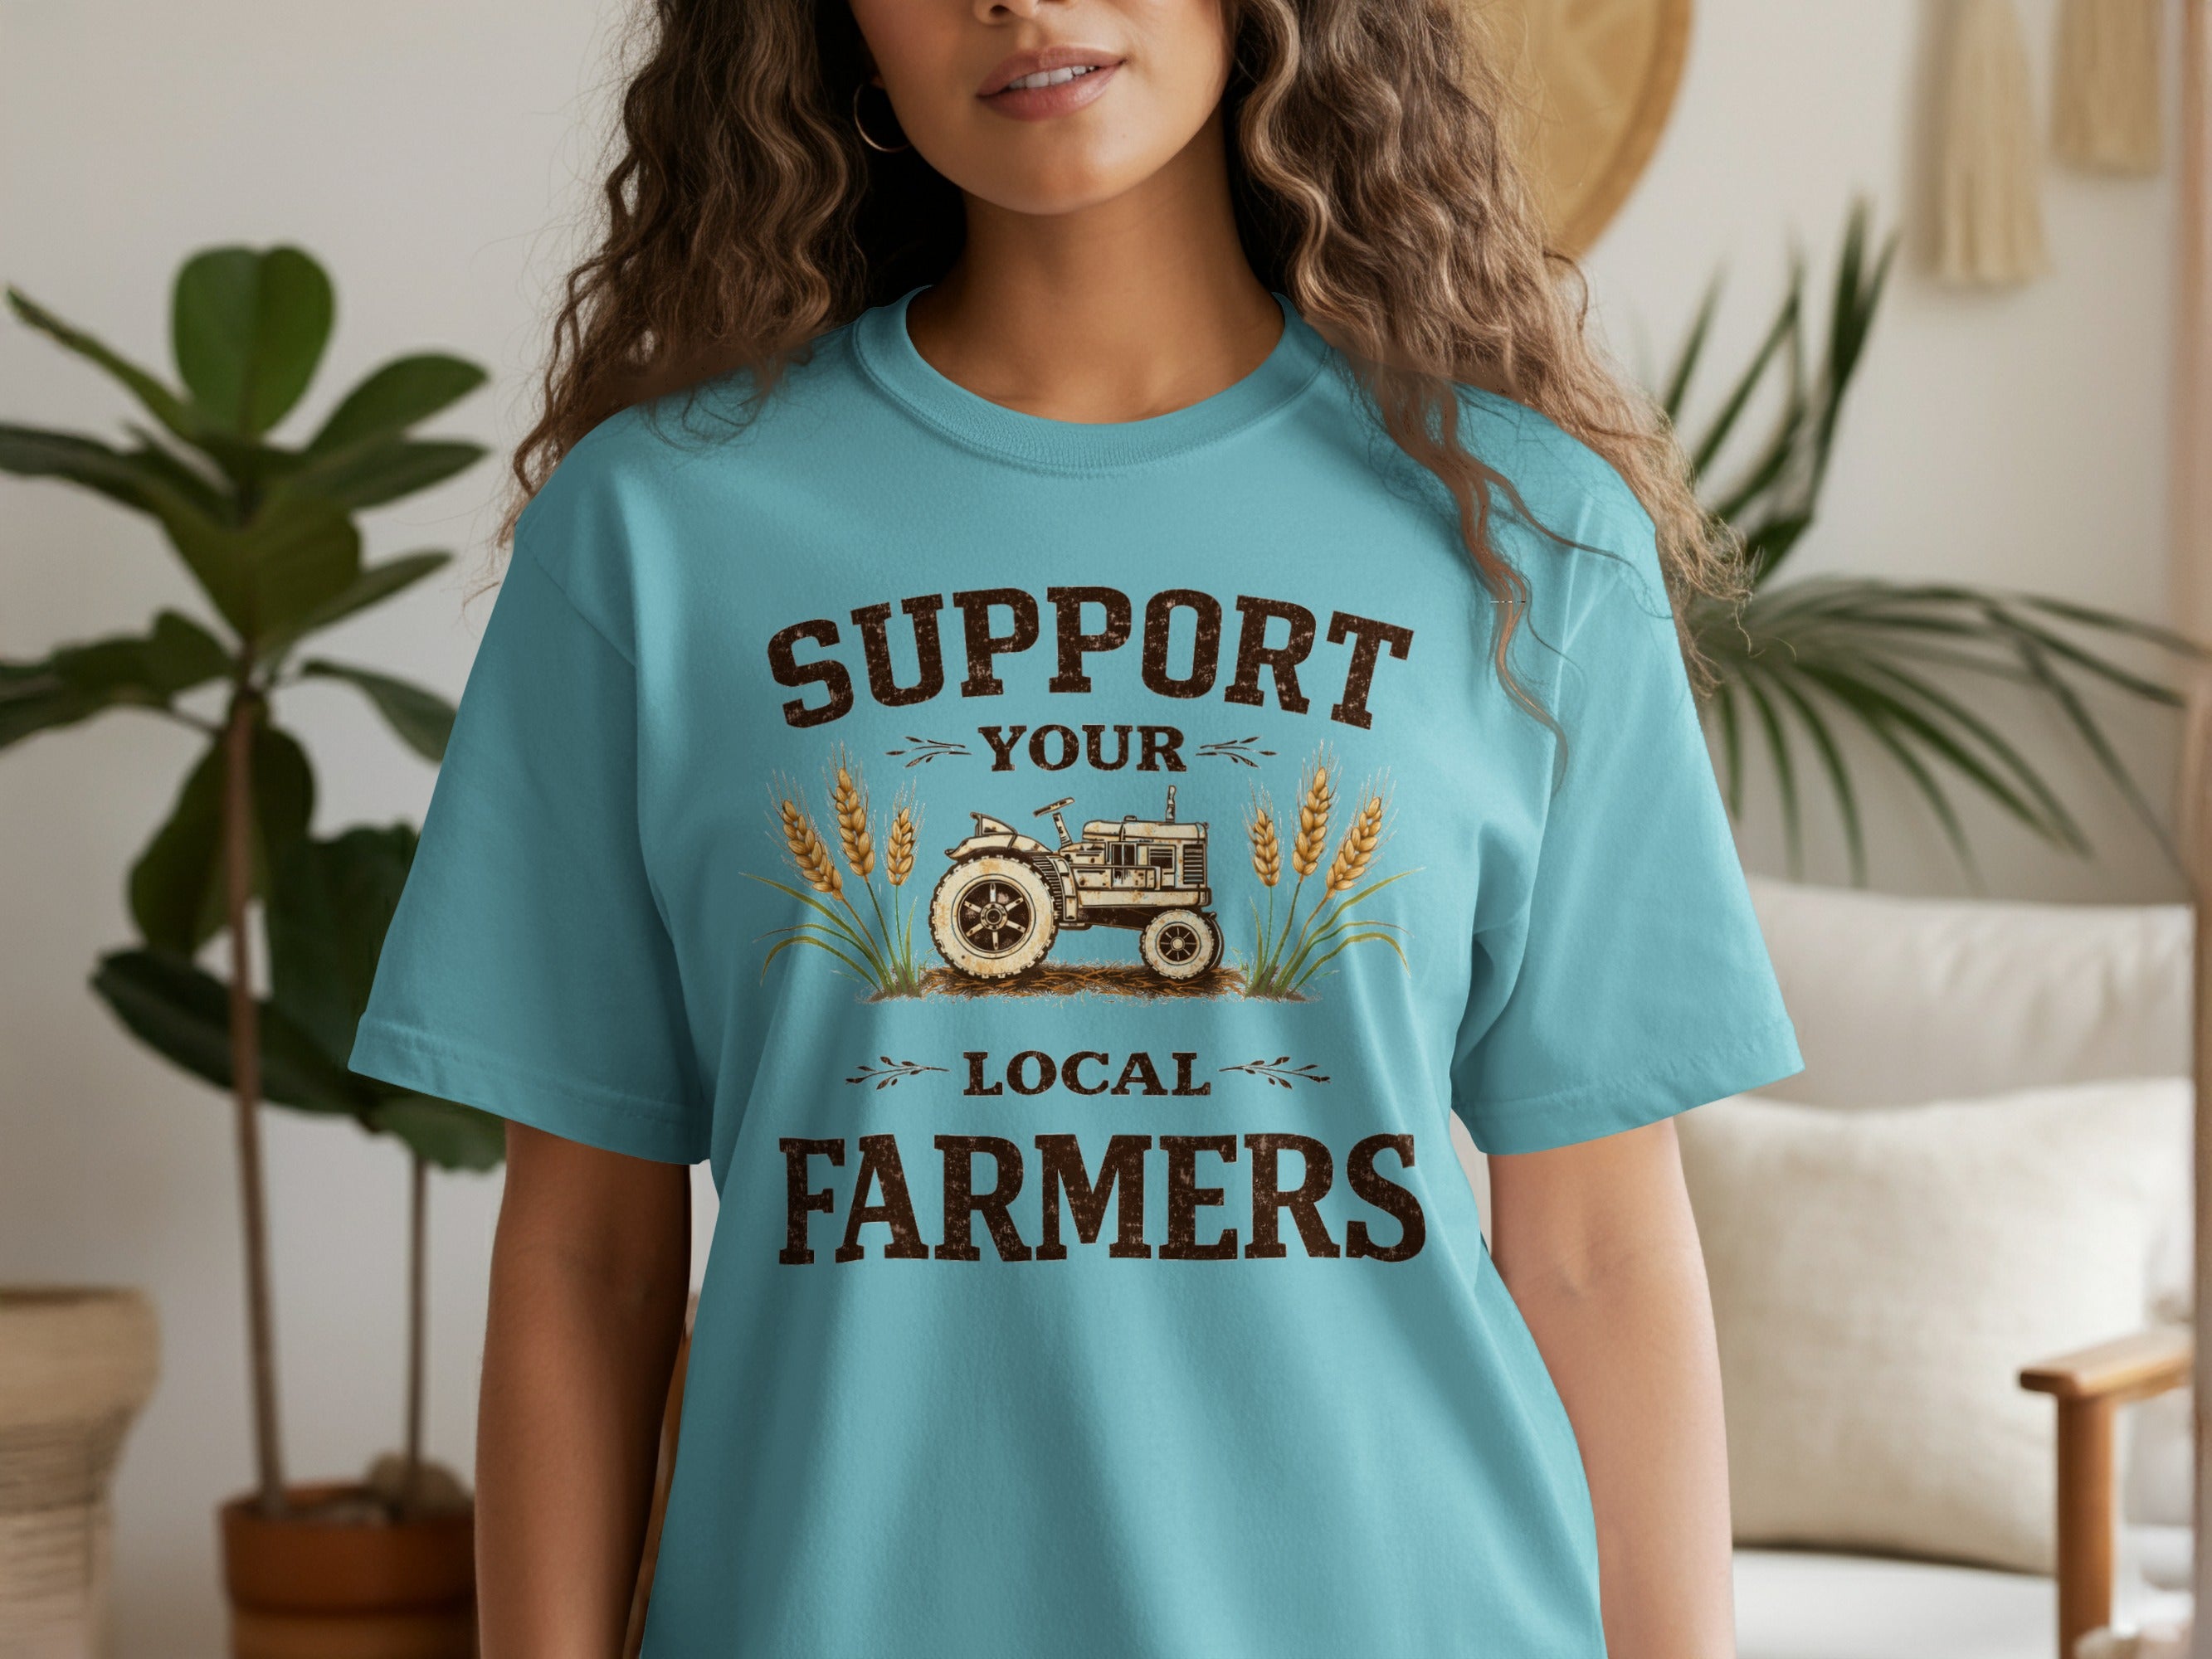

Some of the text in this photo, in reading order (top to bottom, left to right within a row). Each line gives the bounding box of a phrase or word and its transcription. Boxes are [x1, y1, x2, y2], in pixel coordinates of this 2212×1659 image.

[767, 586, 1415, 731] SUPPORT
[977, 724, 1187, 773] YOUR
[962, 1050, 1211, 1097] LOCAL
[778, 1132, 1427, 1265] FARMERS
